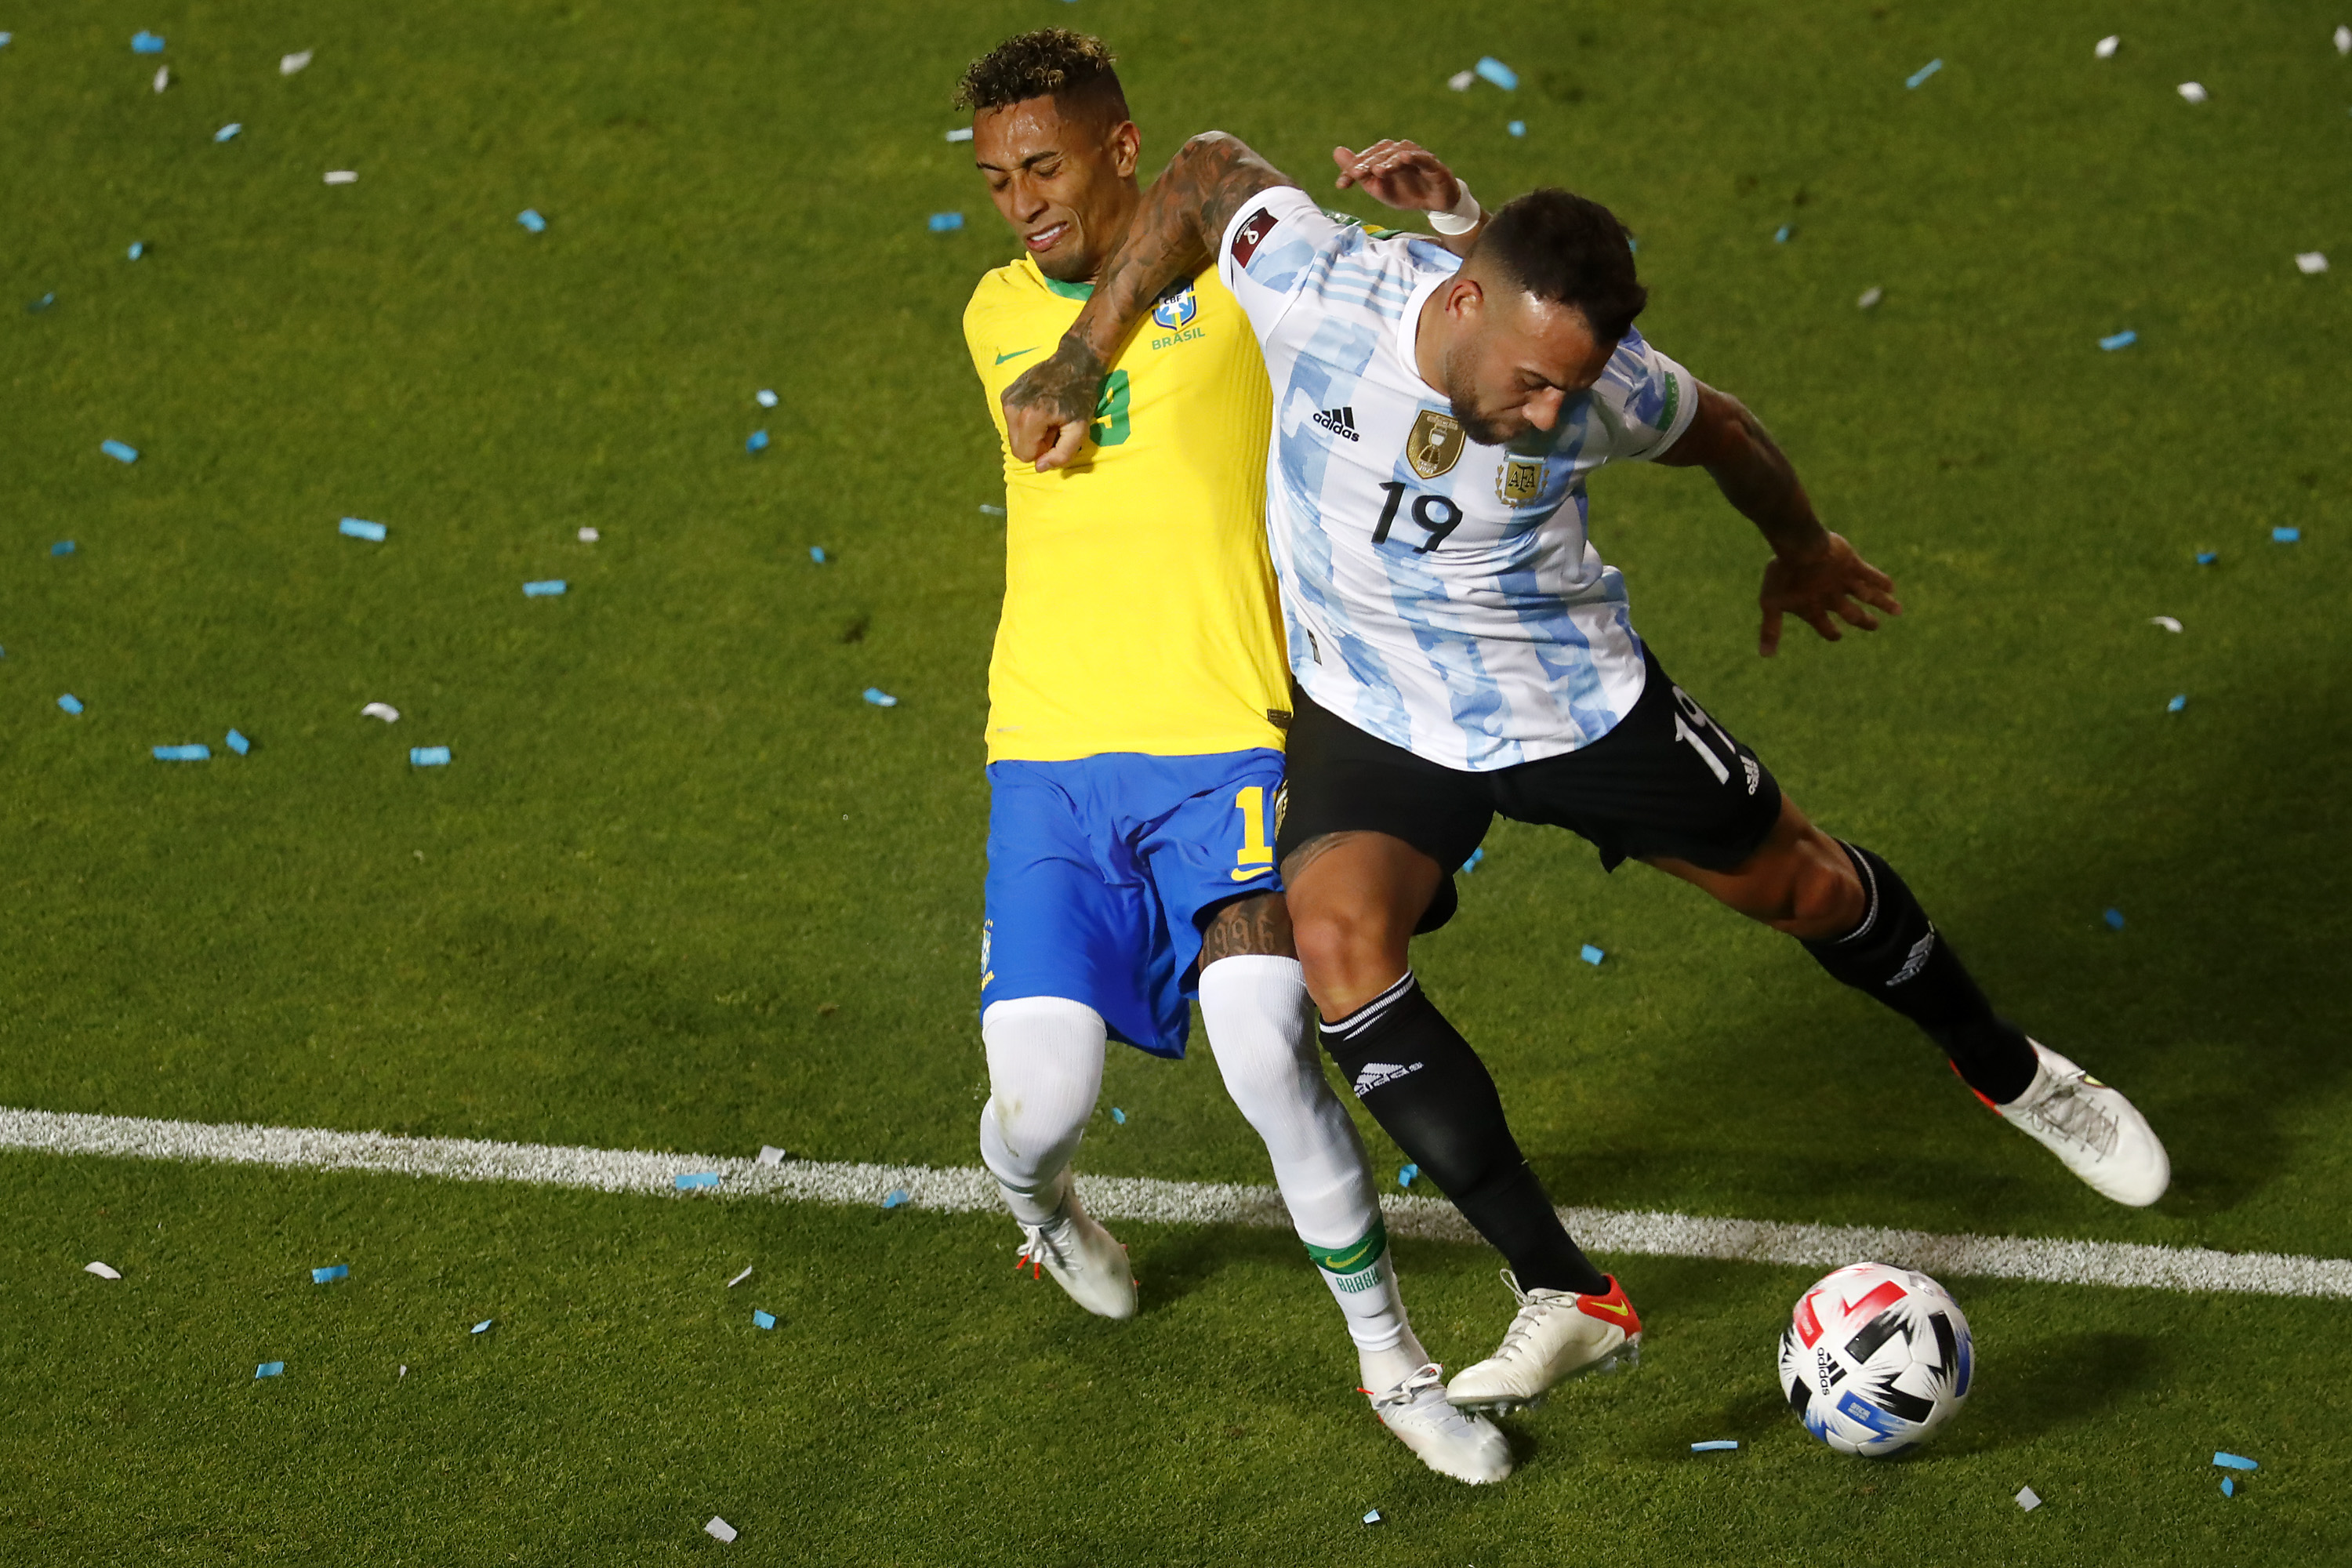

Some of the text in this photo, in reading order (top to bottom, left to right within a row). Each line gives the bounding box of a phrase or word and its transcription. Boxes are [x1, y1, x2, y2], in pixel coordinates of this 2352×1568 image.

[1163, 295, 1181, 305] CBF
[1152, 328, 1206, 350] BRASIL
[1088, 368, 1131, 448] 9
[1313, 412, 1360, 442] adidas
[1508, 463, 1535, 493] AFA
[1371, 481, 1464, 554] 19
[1672, 684, 1737, 786] 19
[1236, 786, 1276, 866] 1
[1817, 1347, 1830, 1396] adidas
